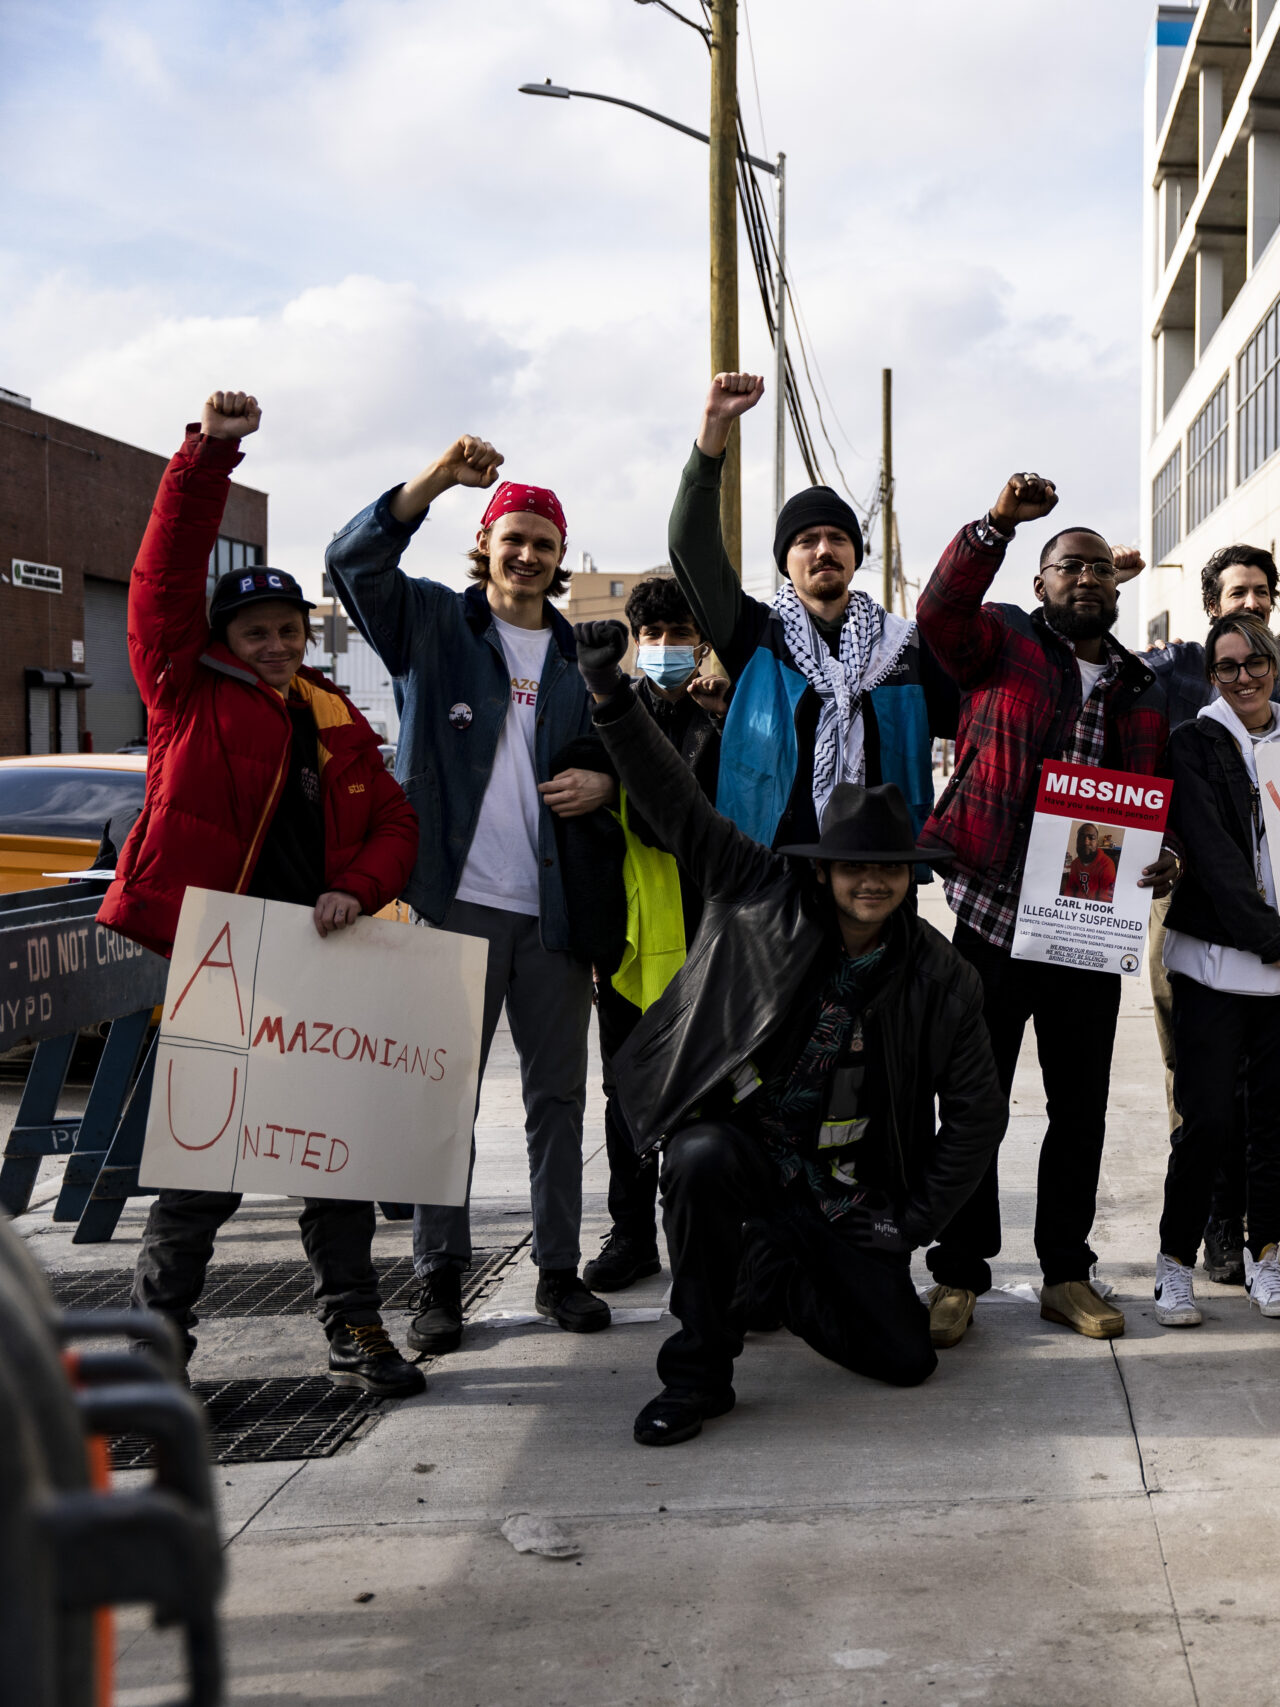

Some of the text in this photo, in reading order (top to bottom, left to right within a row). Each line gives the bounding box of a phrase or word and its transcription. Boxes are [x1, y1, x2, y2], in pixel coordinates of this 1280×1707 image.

[1045, 772, 1164, 810] MISSING
[1044, 796, 1160, 821] Have you seen this person?
[1023, 904, 1143, 931] ILLEGALLY SUSPENDED
[1054, 898, 1114, 915] CARL HOOK
[28, 936, 51, 982] DO
[57, 929, 89, 976] NOT
